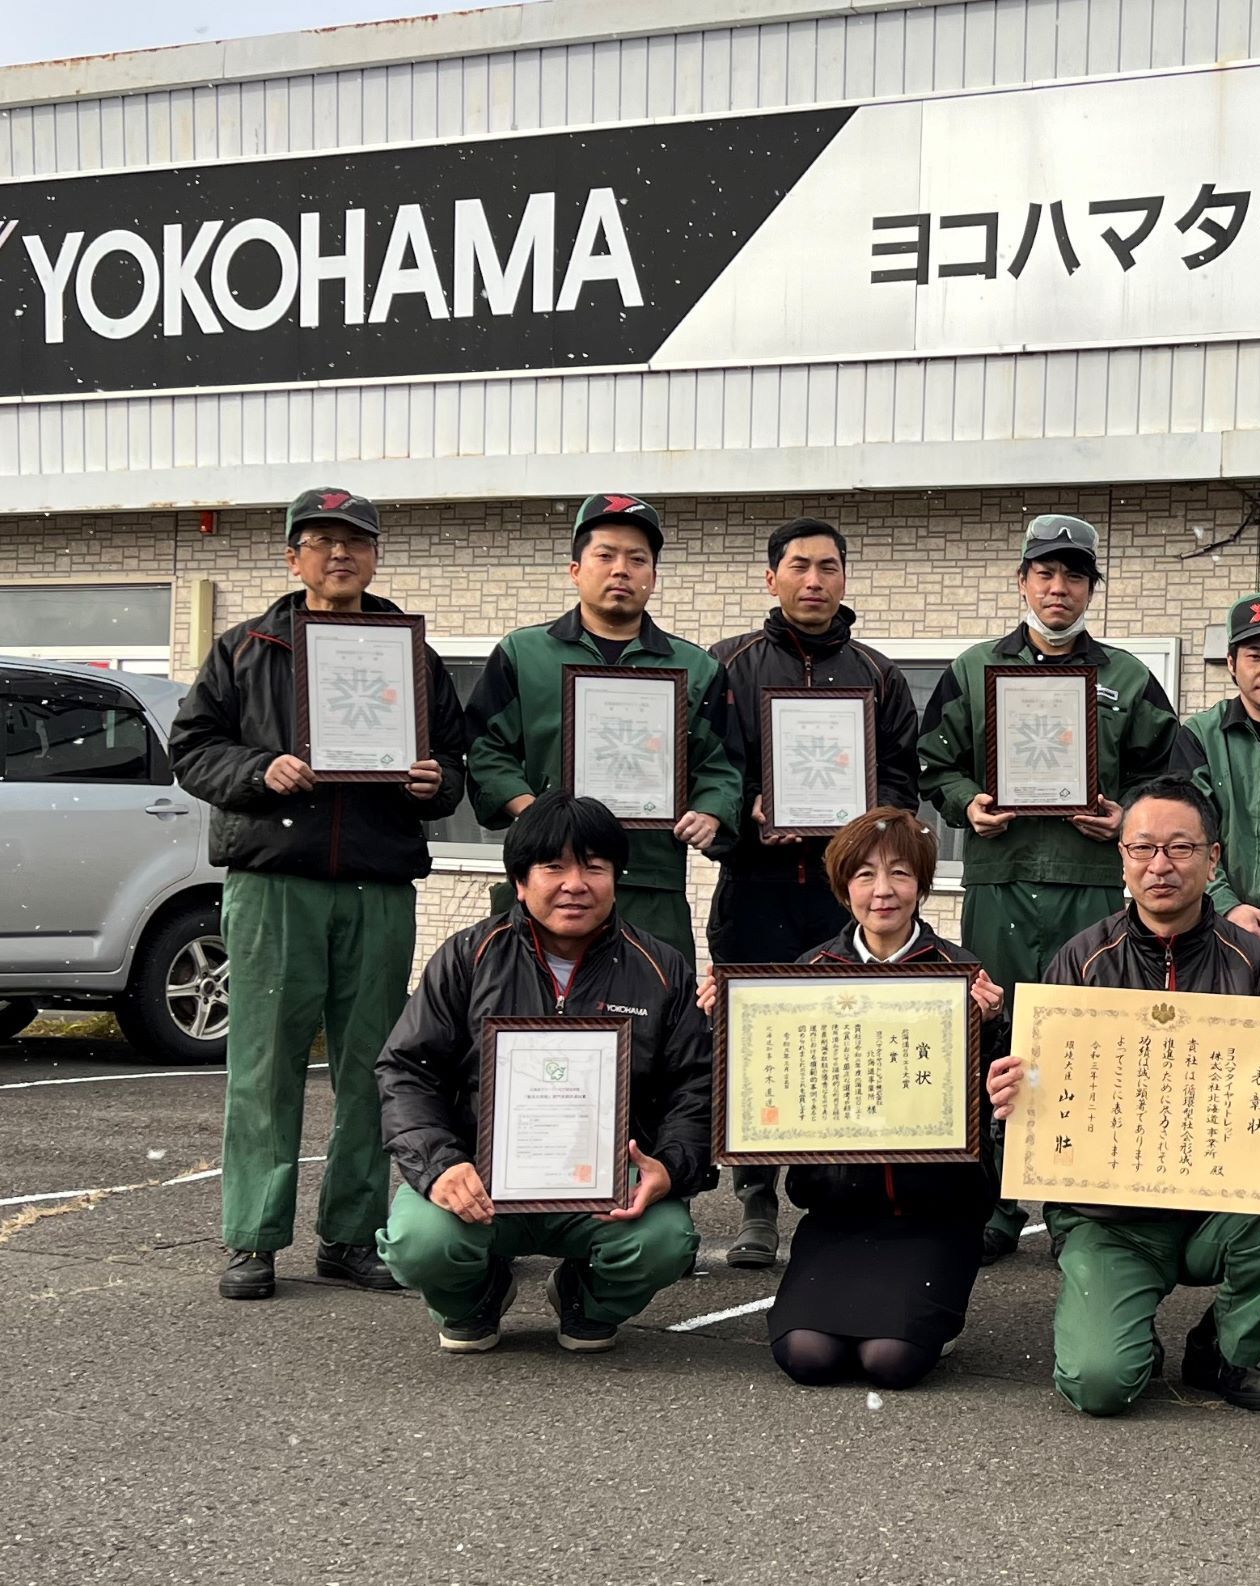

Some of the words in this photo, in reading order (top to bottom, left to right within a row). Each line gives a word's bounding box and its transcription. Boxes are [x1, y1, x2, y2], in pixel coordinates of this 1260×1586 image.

[22, 187, 644, 343] YOKOHAMA
[889, 1034, 898, 1063] 大賞
[914, 1041, 932, 1085] 賞状
